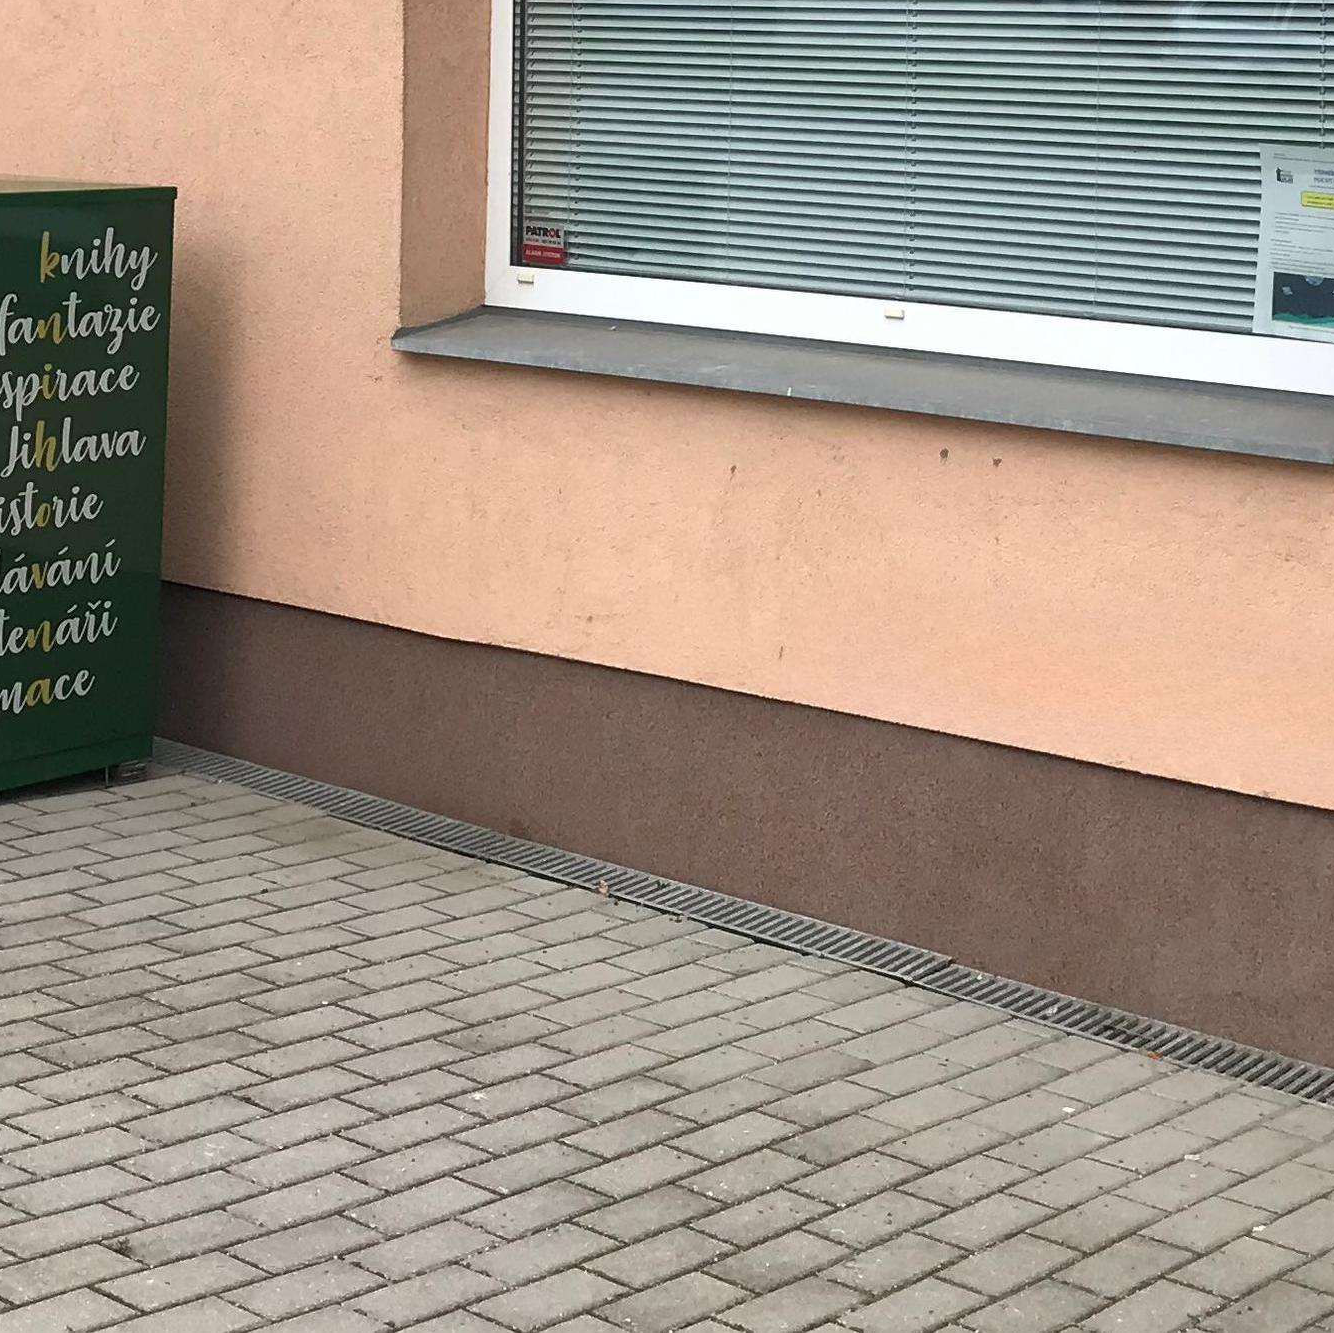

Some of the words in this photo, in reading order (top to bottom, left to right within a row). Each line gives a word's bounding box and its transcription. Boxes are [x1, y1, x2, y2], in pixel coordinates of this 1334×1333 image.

[39, 226, 158, 291] knihy
[526, 226, 561, 238] PATROL
[0, 417, 147, 478] Jihlava
